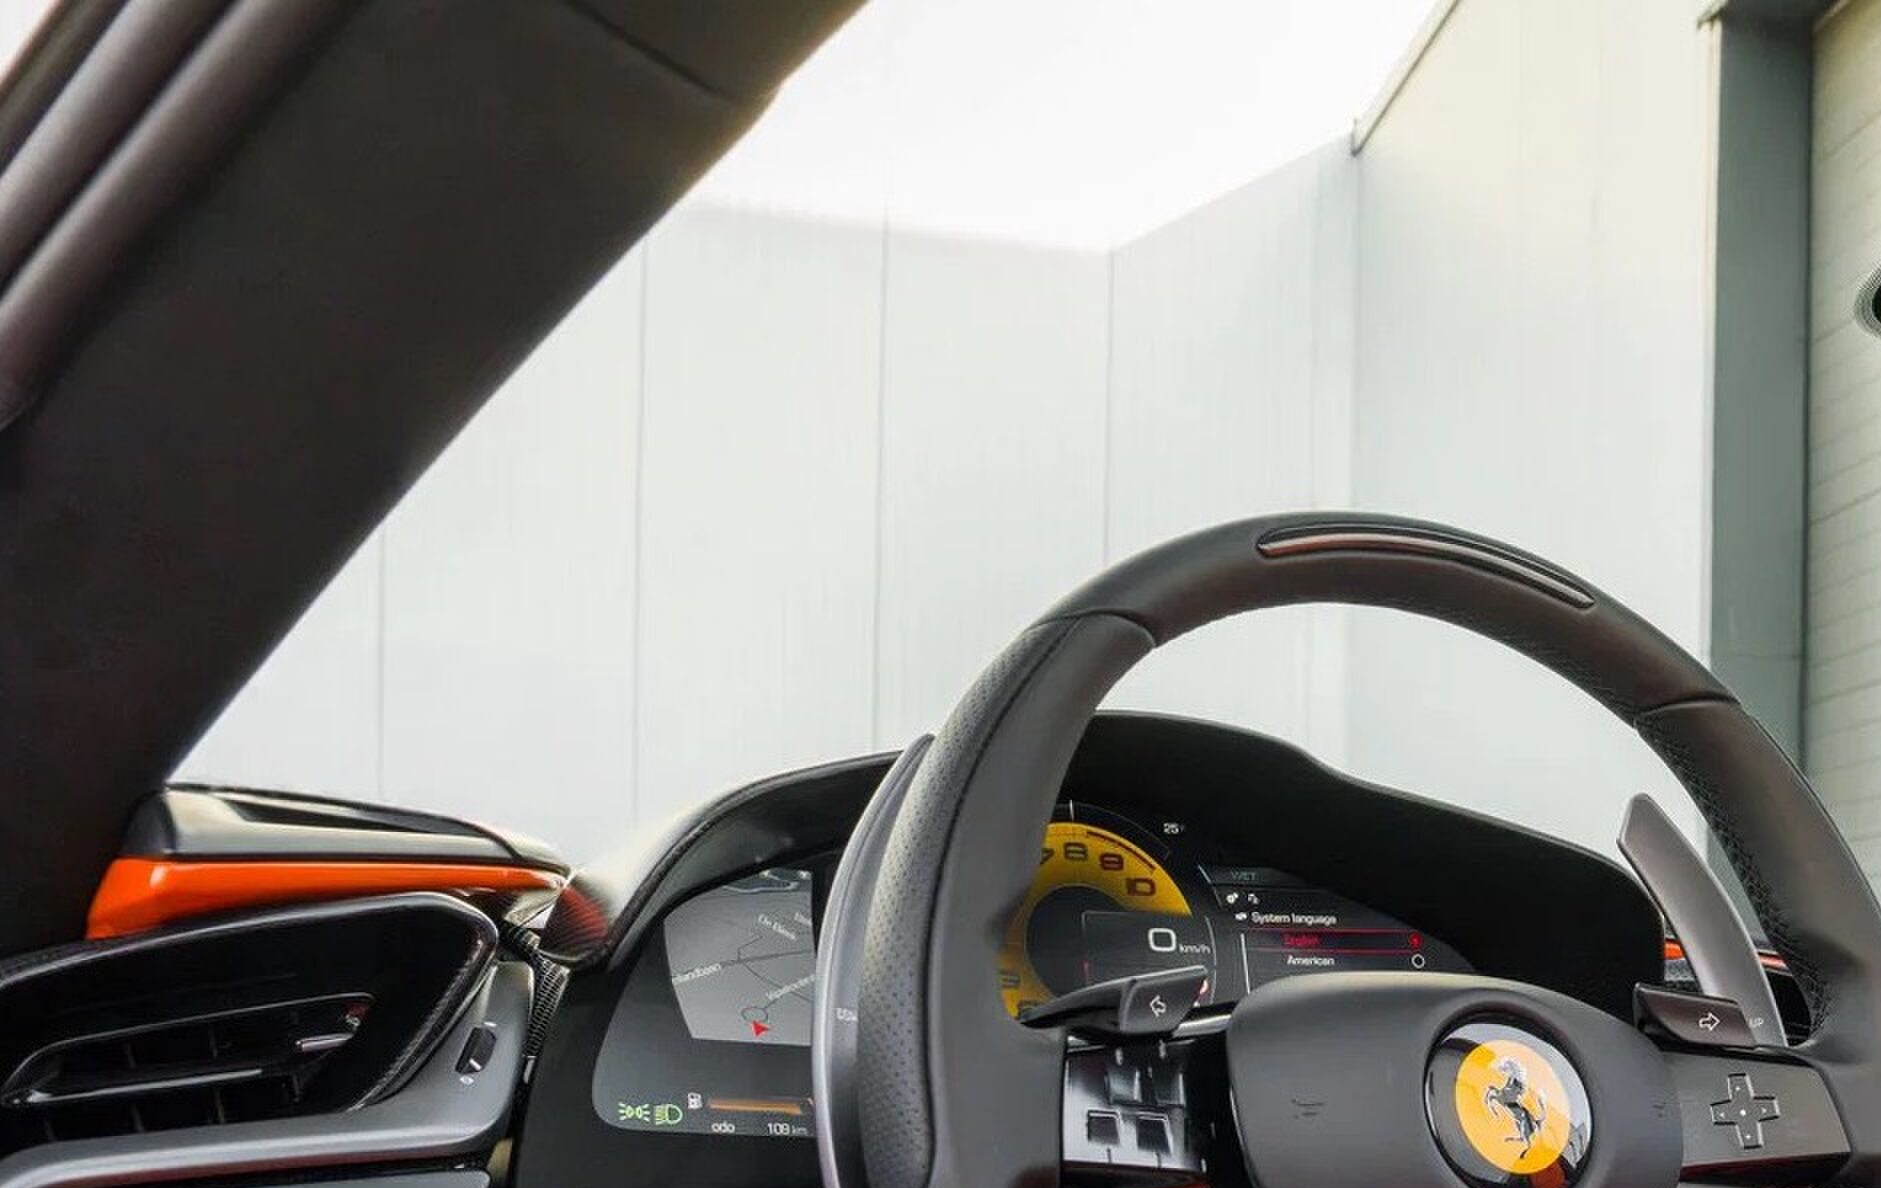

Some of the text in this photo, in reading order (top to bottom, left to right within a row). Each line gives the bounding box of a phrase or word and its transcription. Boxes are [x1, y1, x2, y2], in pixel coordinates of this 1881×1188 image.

[1063, 842, 1088, 861] 8
[1100, 853, 1124, 871] 9
[1126, 878, 1156, 896] 10
[1251, 912, 1337, 925] System language
[1148, 928, 1211, 954] 0 km/h
[1287, 955, 1336, 966] American
[711, 1120, 736, 1133] odo
